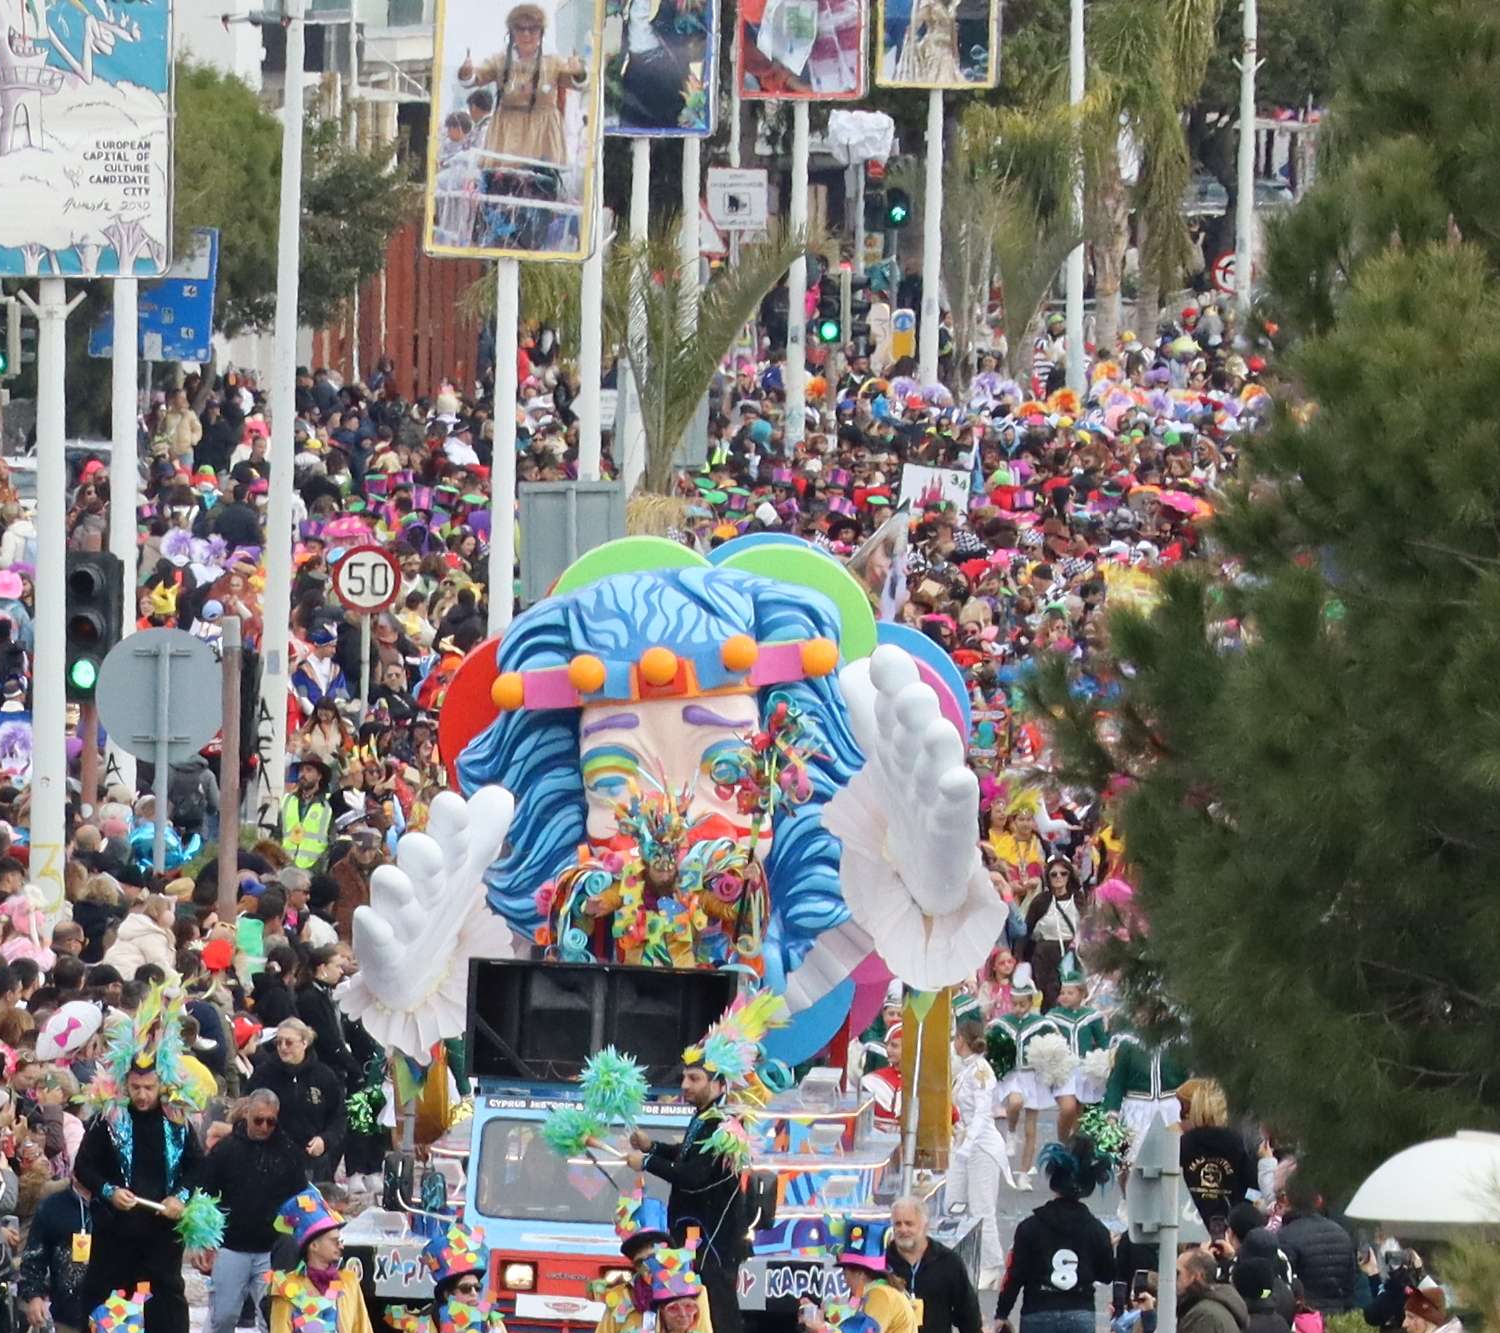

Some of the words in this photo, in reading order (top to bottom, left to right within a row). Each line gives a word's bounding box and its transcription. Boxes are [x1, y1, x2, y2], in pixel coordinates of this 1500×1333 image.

[96, 141, 151, 150] EUROPEAN
[83, 152, 129, 161] CAPITAL
[136, 152, 150, 161] OF
[104, 164, 150, 173] CULTURE
[89, 175, 150, 185] CANDIDATE
[123, 187, 150, 196] CITY
[347, 562, 389, 596] 50
[489, 1099, 527, 1108] CYPRUS
[661, 1106, 698, 1116] MUSEU
